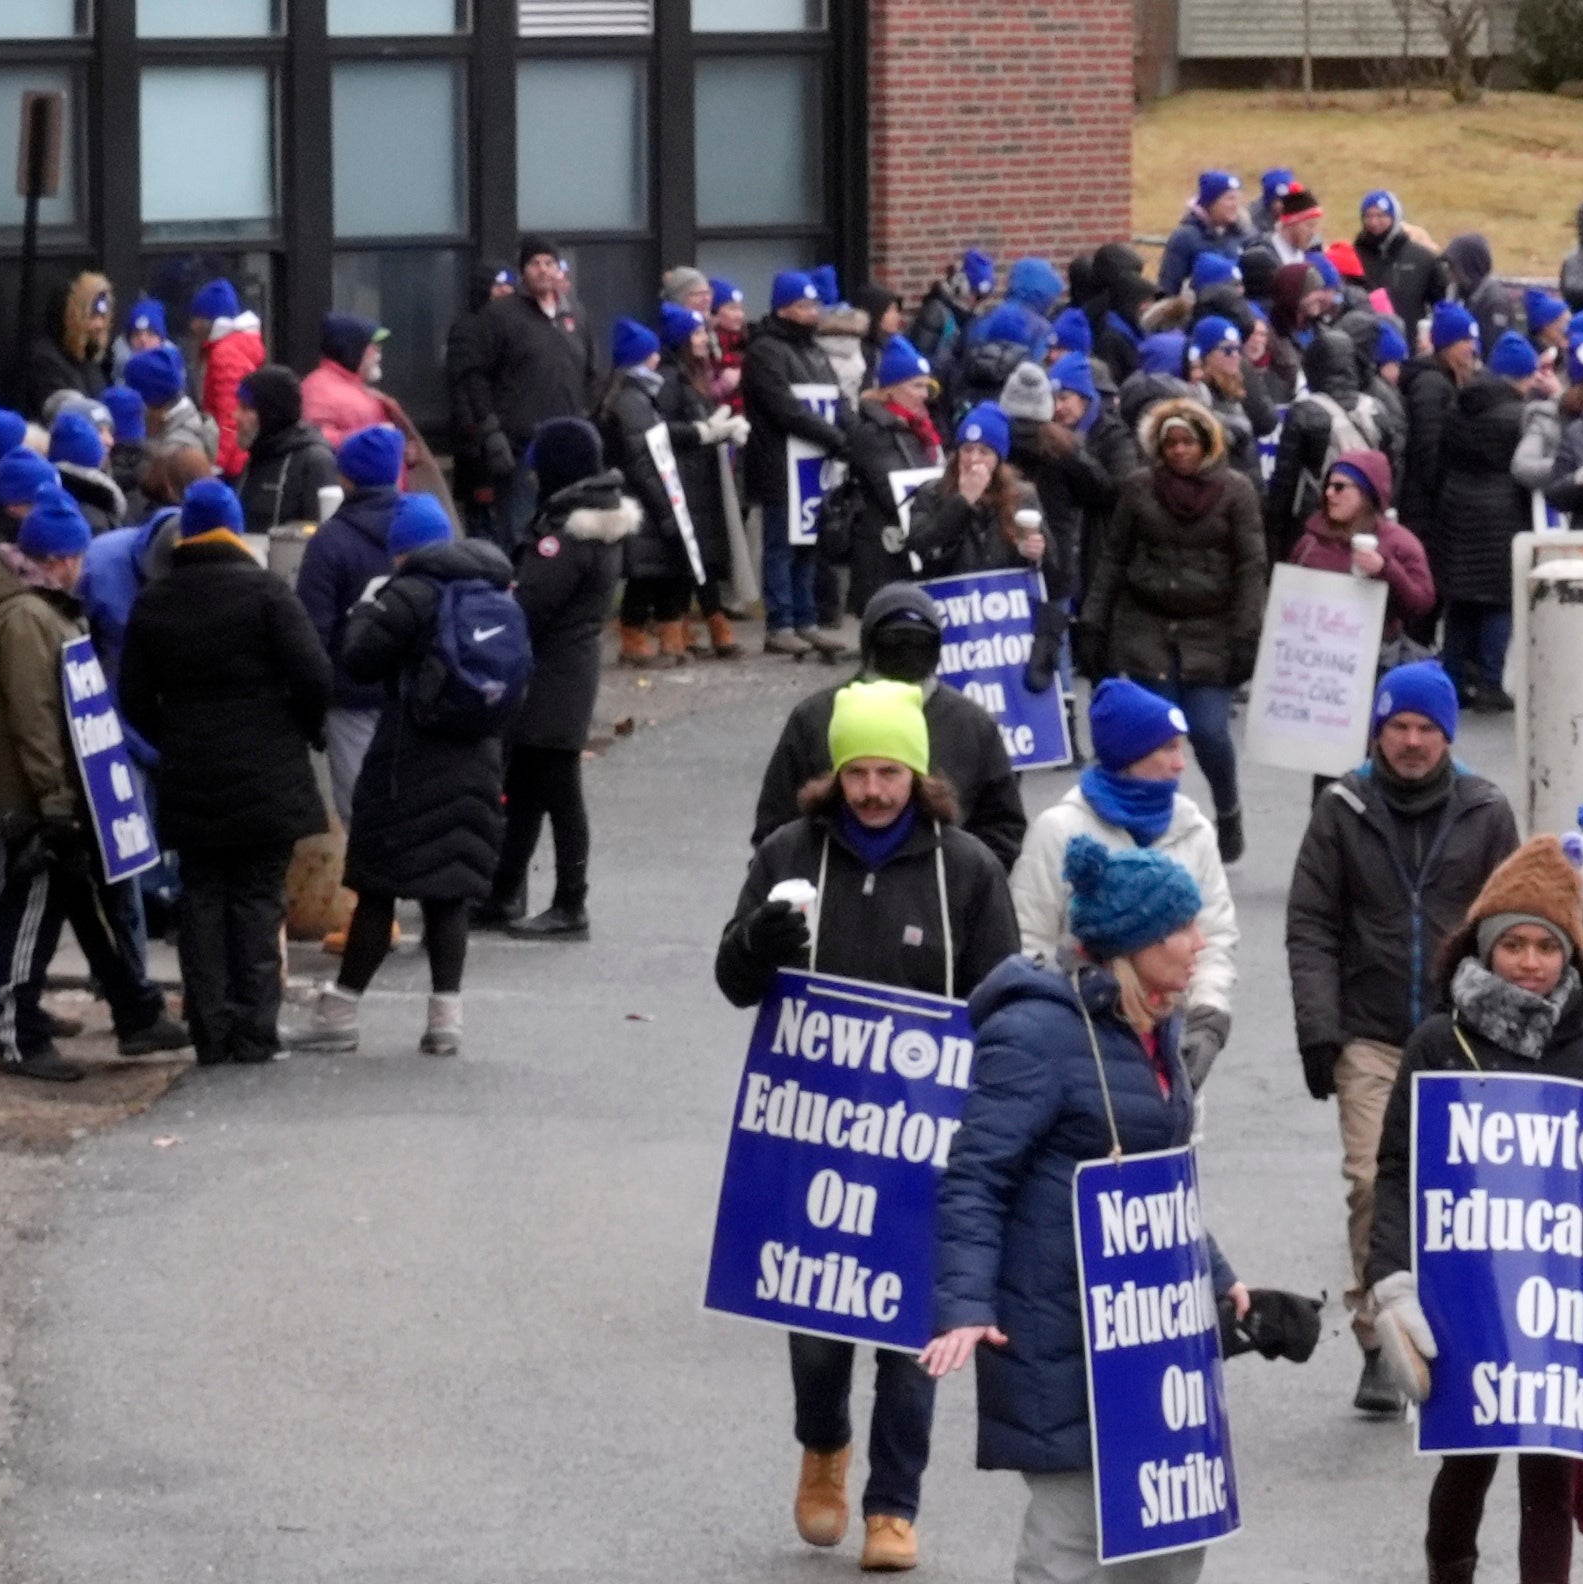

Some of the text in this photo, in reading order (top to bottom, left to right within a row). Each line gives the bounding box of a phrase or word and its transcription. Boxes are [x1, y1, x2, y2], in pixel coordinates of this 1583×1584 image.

[932, 588, 1031, 629] ewton
[935, 632, 1035, 675] ucator
[771, 997, 973, 1090] Newton
[740, 1073, 962, 1169] Educator
[806, 1169, 878, 1237] On
[1097, 1180, 1200, 1258] Newto
[756, 1240, 904, 1323] Strike
[1161, 1364, 1207, 1432] On
[1138, 1452, 1228, 1529] Strike
